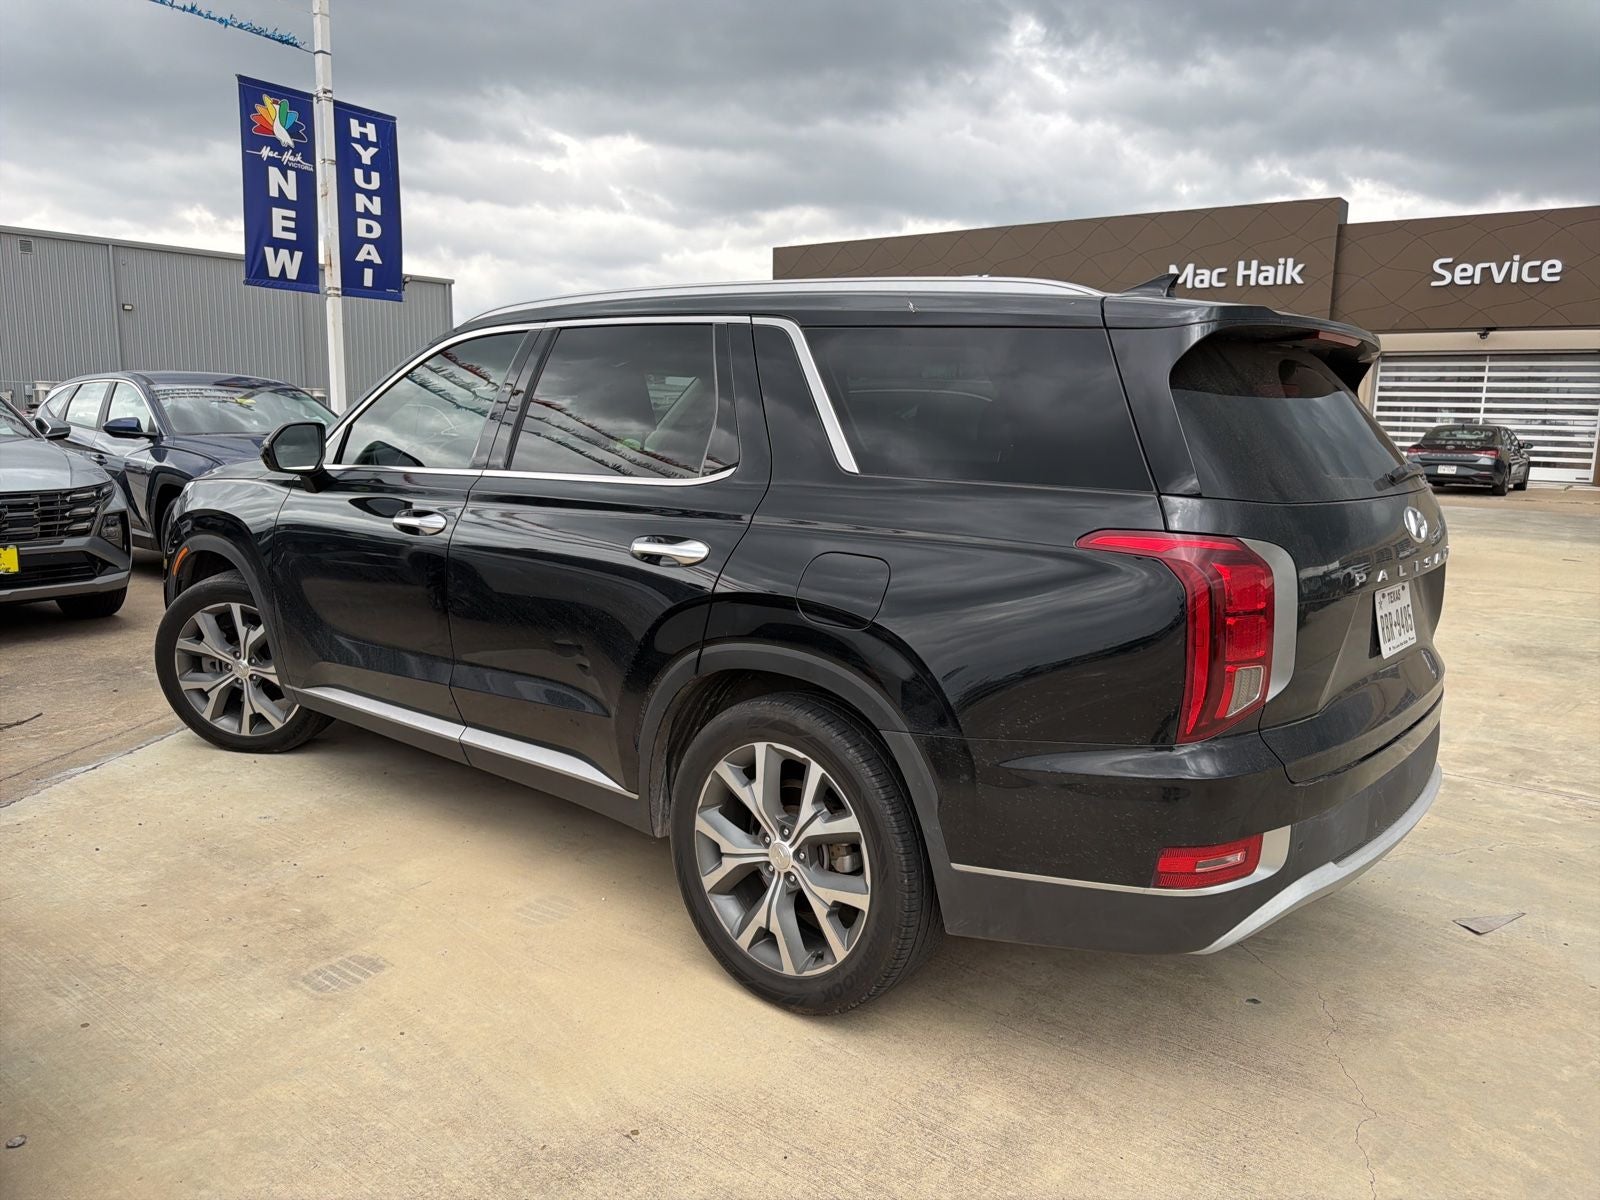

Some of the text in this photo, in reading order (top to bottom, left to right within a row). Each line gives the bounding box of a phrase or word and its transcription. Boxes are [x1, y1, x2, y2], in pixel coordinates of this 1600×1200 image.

[246, 145, 313, 165] Mac Haik
[288, 161, 314, 173] VICTORIA
[350, 118, 382, 287] HYUNDAI
[264, 166, 303, 280] NEW
[1168, 257, 1305, 289] Mac Haik
[1430, 254, 1563, 288] Service
[1387, 588, 1402, 605] TEXAS
